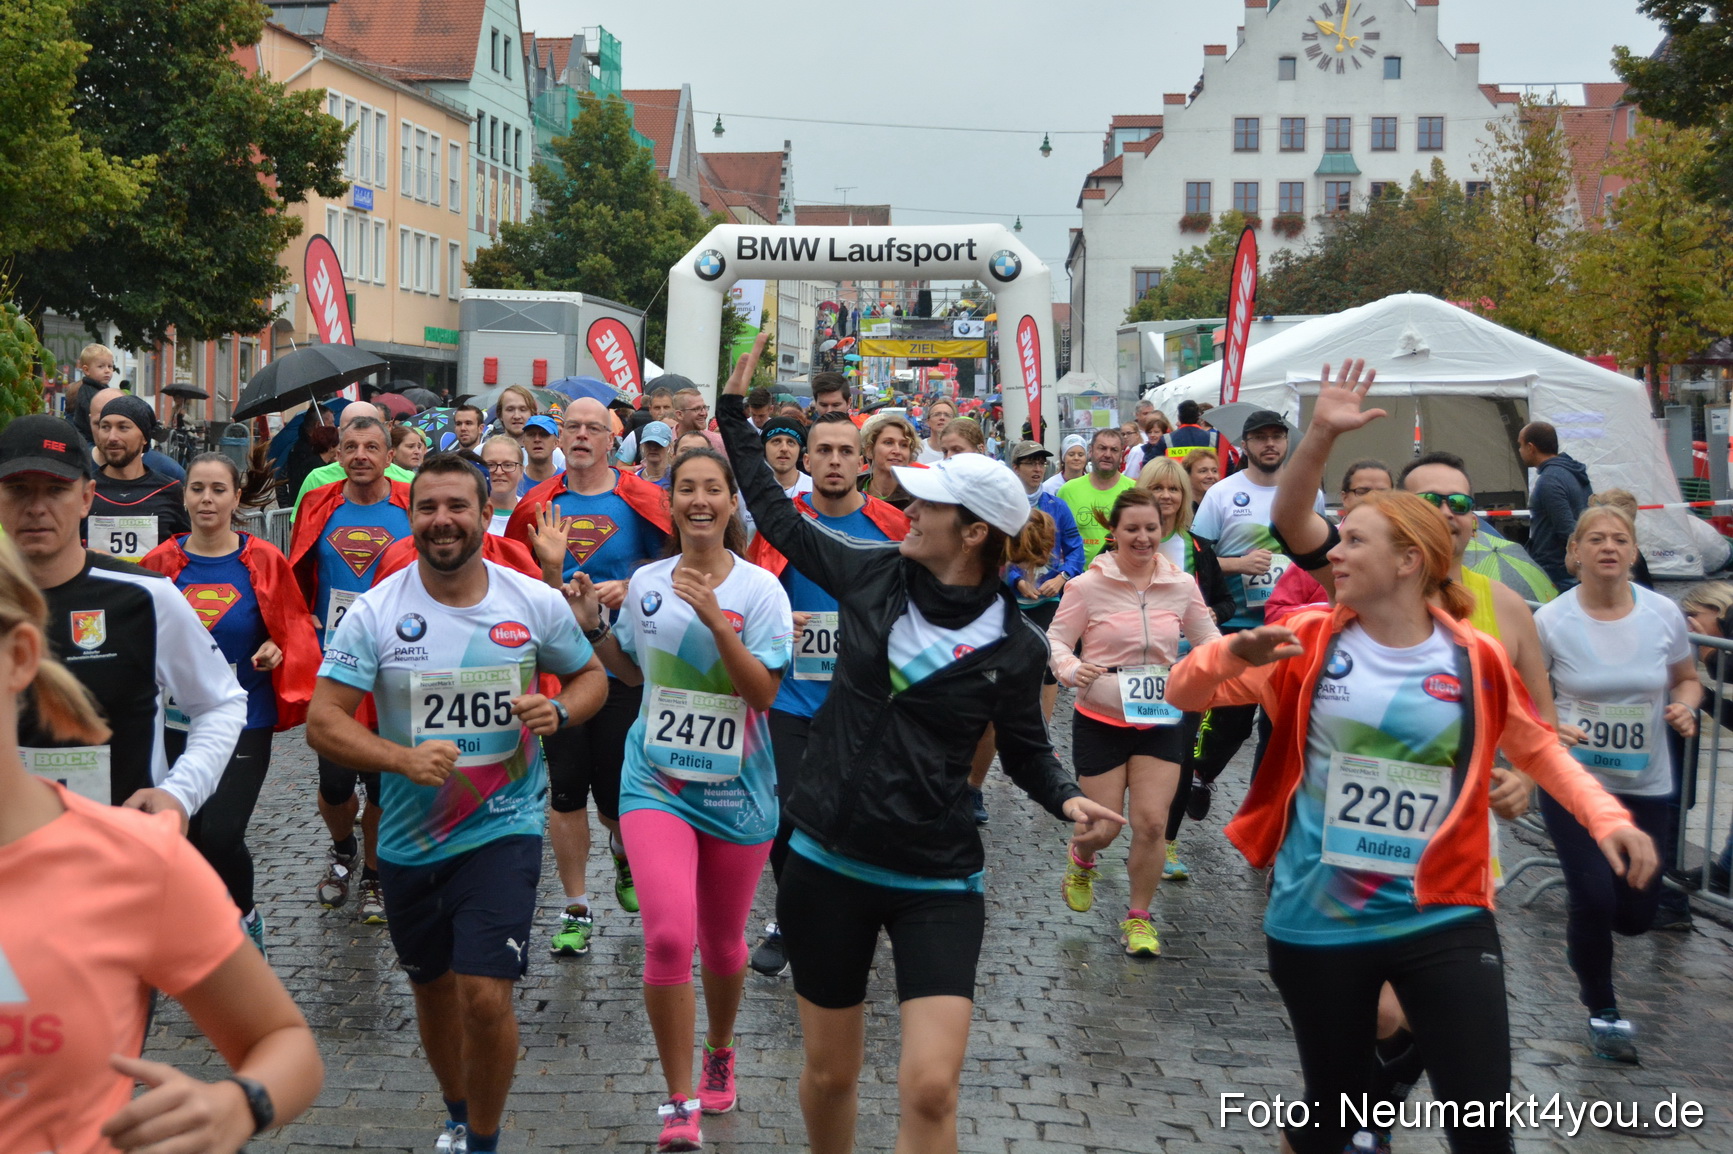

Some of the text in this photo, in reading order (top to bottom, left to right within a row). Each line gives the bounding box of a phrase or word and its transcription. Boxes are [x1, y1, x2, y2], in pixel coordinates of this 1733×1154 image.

[737, 236, 977, 267] BMW Laufsport
[909, 343, 938, 354] ZIEL
[595, 329, 641, 402] REWE
[1020, 326, 1039, 403] REWE
[110, 531, 138, 554] 59
[802, 629, 839, 654] 208
[395, 647, 428, 655] PARTL
[822, 661, 836, 671] Ma
[461, 670, 511, 683] BOCK
[1128, 677, 1165, 700] 209
[424, 690, 513, 729] 2465
[693, 695, 738, 709] BOCK
[1137, 706, 1169, 716] Katarina
[656, 709, 736, 750] 2470
[1577, 718, 1644, 750] 2908
[457, 738, 480, 752] Roi
[35, 751, 97, 766] BOCK
[670, 752, 712, 769] Paticia
[1594, 754, 1621, 767] Doro
[1340, 766, 1379, 777] NeuerMarkt
[1388, 764, 1441, 784] BOCK
[703, 799, 745, 809] Stadtlauf
[1338, 782, 1439, 832] 2267
[1355, 836, 1411, 859] Andrea
